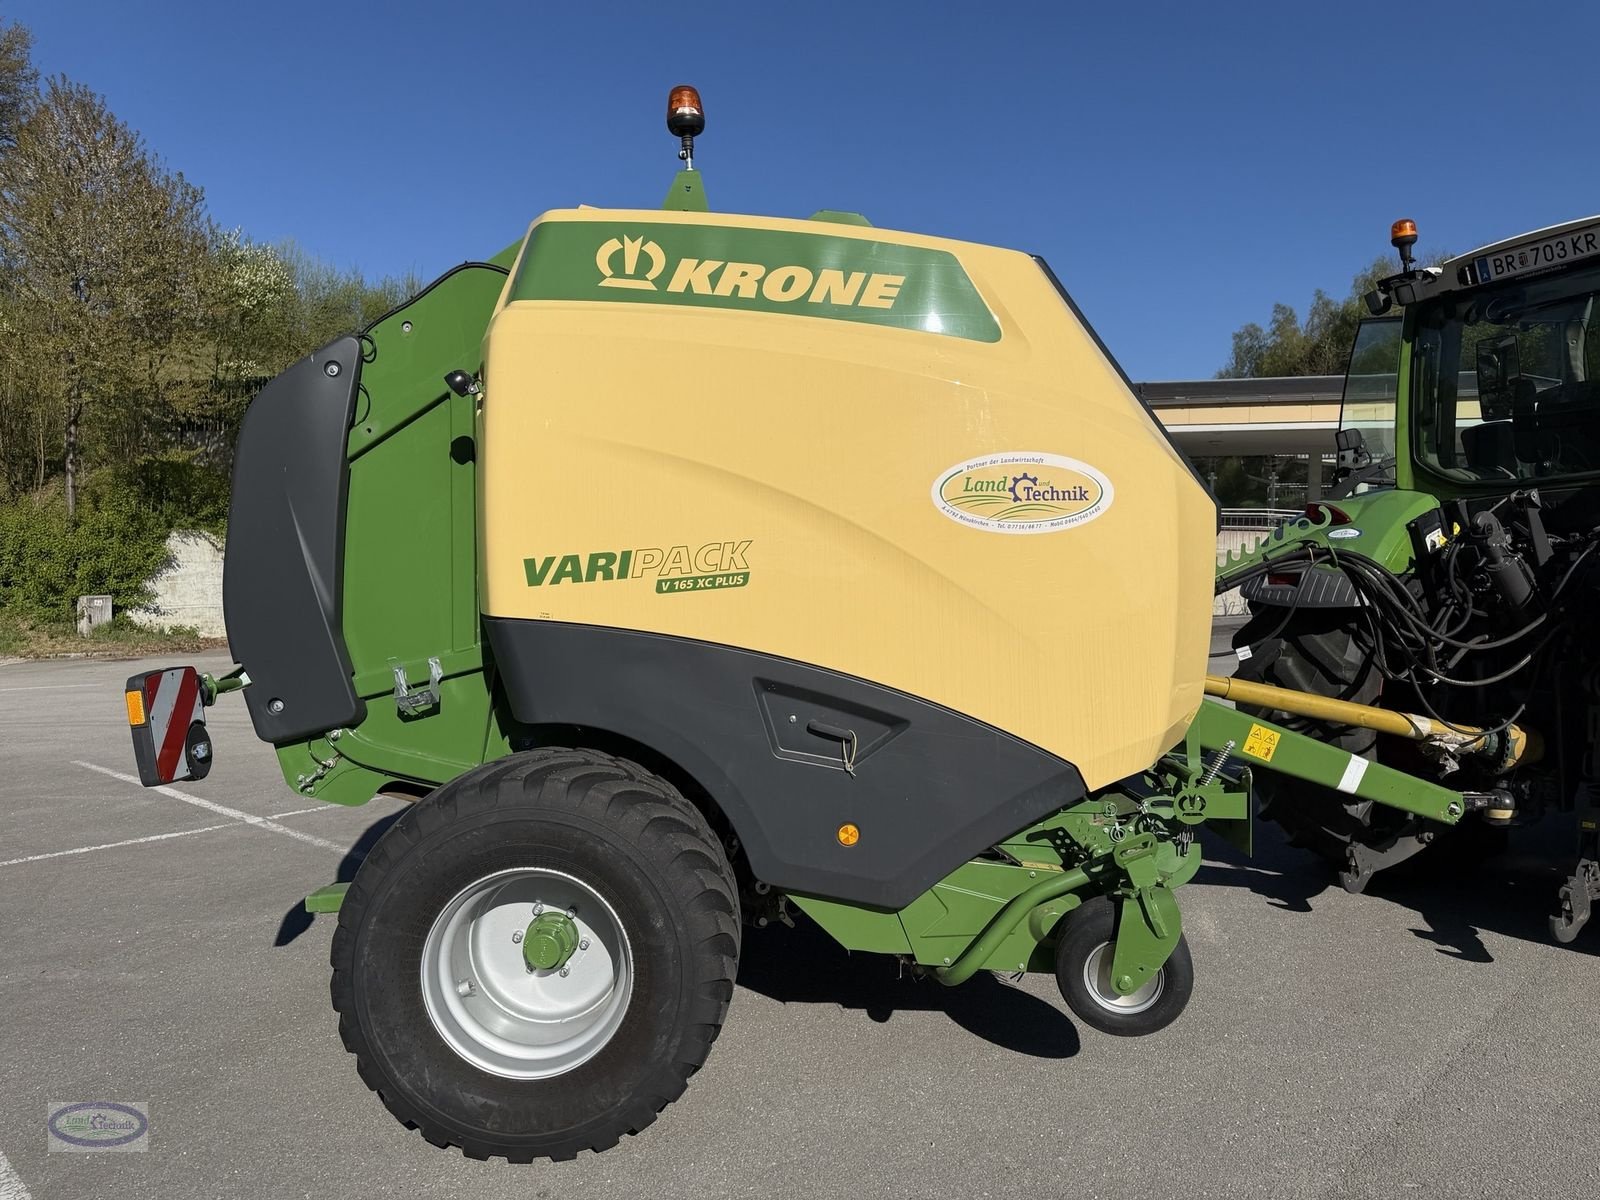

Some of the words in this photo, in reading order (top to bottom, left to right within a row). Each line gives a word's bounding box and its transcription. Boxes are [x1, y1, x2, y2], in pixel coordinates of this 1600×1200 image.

[1492, 254, 1517, 275] BR
[1530, 240, 1567, 266] 703
[1571, 233, 1598, 256] KR
[666, 257, 906, 310] KRONE
[966, 461, 988, 471] Partner
[1000, 456, 1044, 465] Landwirtschaft
[963, 476, 1008, 492] Land
[1023, 486, 1089, 501] Technik
[523, 540, 753, 587] VARIPACK
[661, 581, 670, 591] V
[673, 579, 693, 591] 165
[696, 577, 713, 588] XC
[715, 574, 744, 587] PLUS
